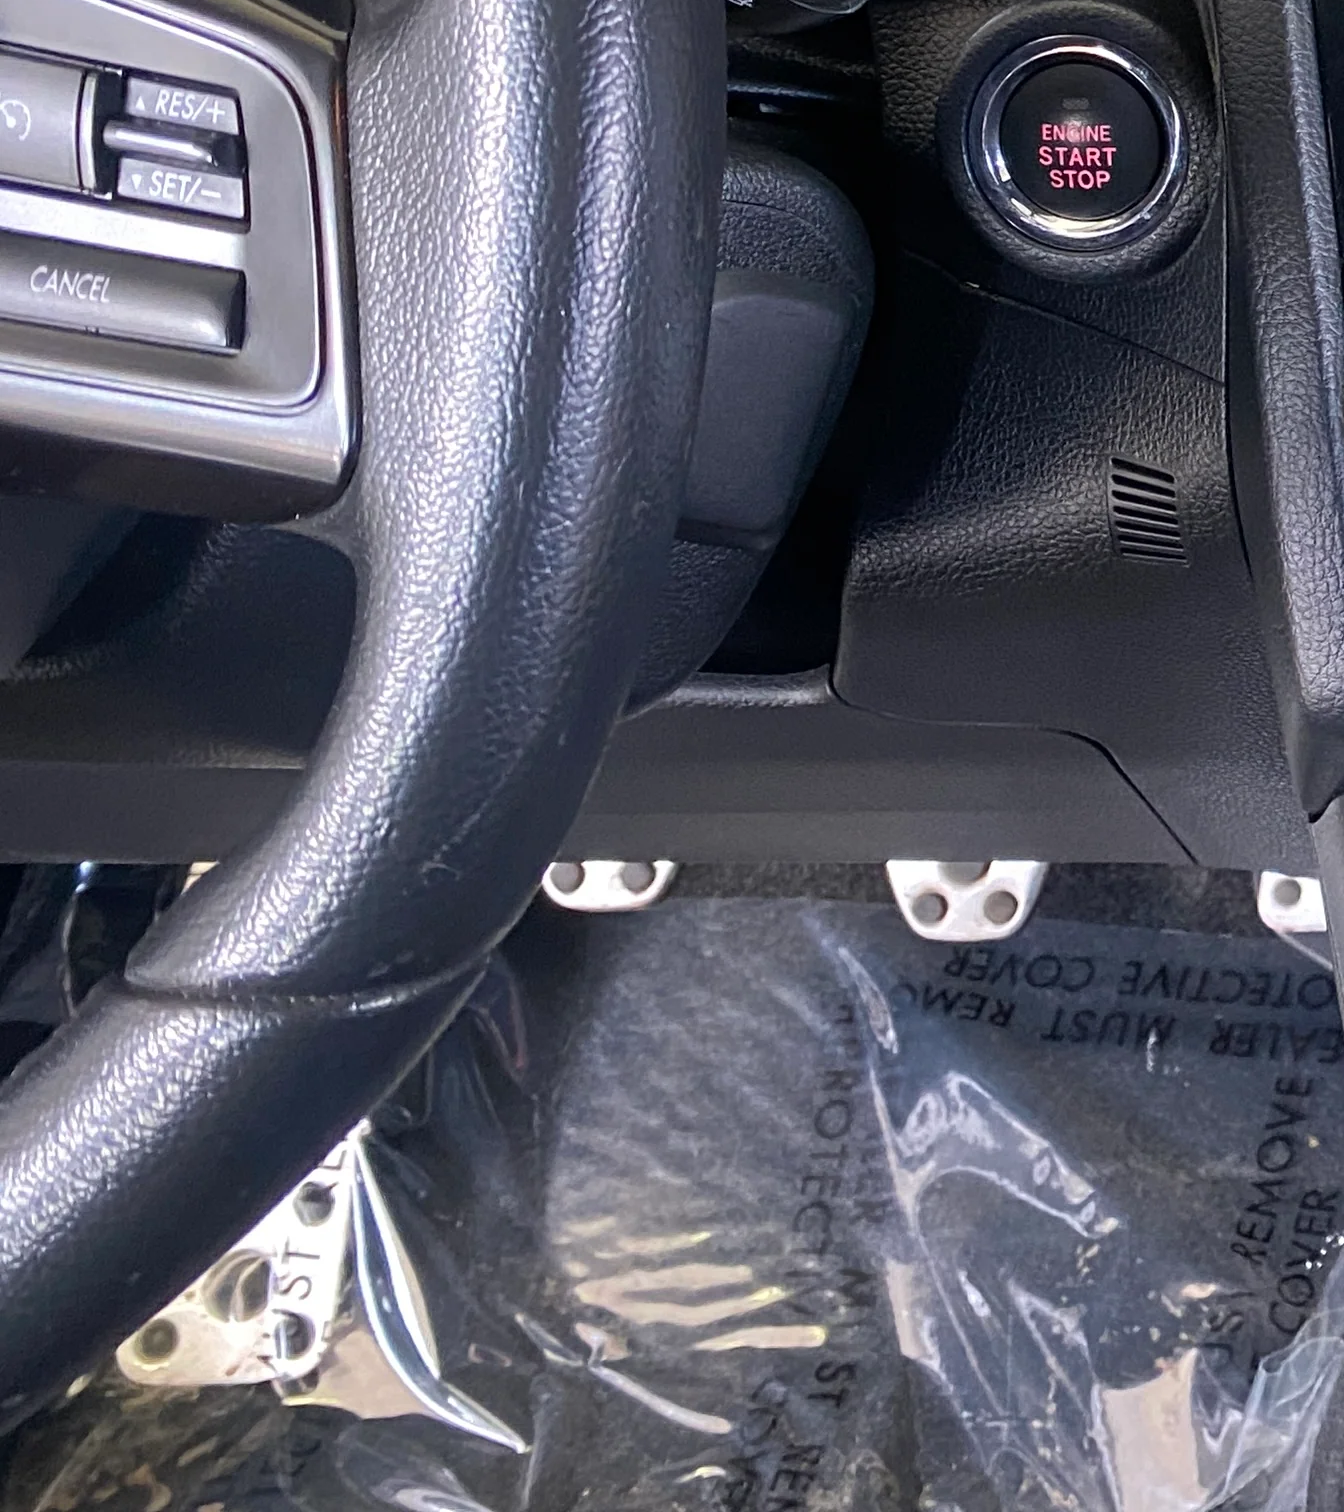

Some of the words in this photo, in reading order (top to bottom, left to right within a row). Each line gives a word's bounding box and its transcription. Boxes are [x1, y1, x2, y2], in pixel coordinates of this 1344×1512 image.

[1041, 124, 1112, 142] ENGINE
[1038, 146, 1117, 168] START
[1049, 169, 1111, 190] STOP
[30, 265, 111, 304] CANCEL
[943, 944, 1095, 990] COVER
[1121, 958, 1339, 1012] OTECTIVE
[1040, 1006, 1176, 1049] MUST
[1231, 1075, 1316, 1266] REMOVE
[1267, 1188, 1341, 1335] COVER
